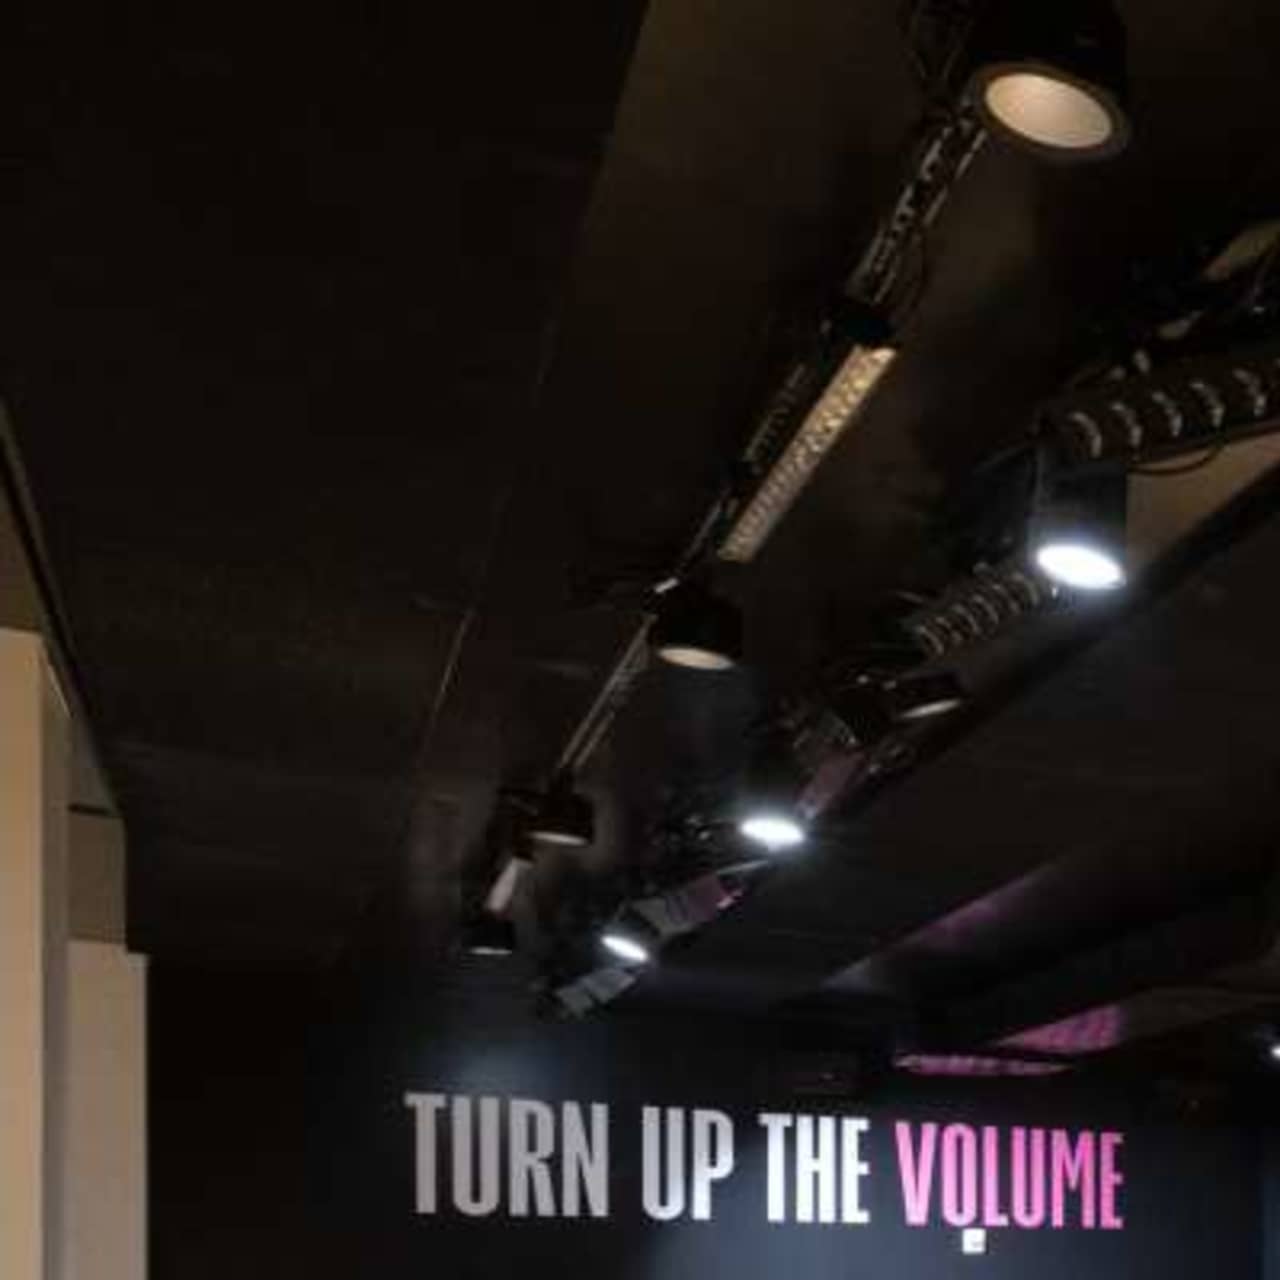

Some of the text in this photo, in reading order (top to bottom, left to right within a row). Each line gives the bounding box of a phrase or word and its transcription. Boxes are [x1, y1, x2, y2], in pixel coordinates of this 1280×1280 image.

[406, 1093, 1124, 1230] TURN UP THE VOLUME
